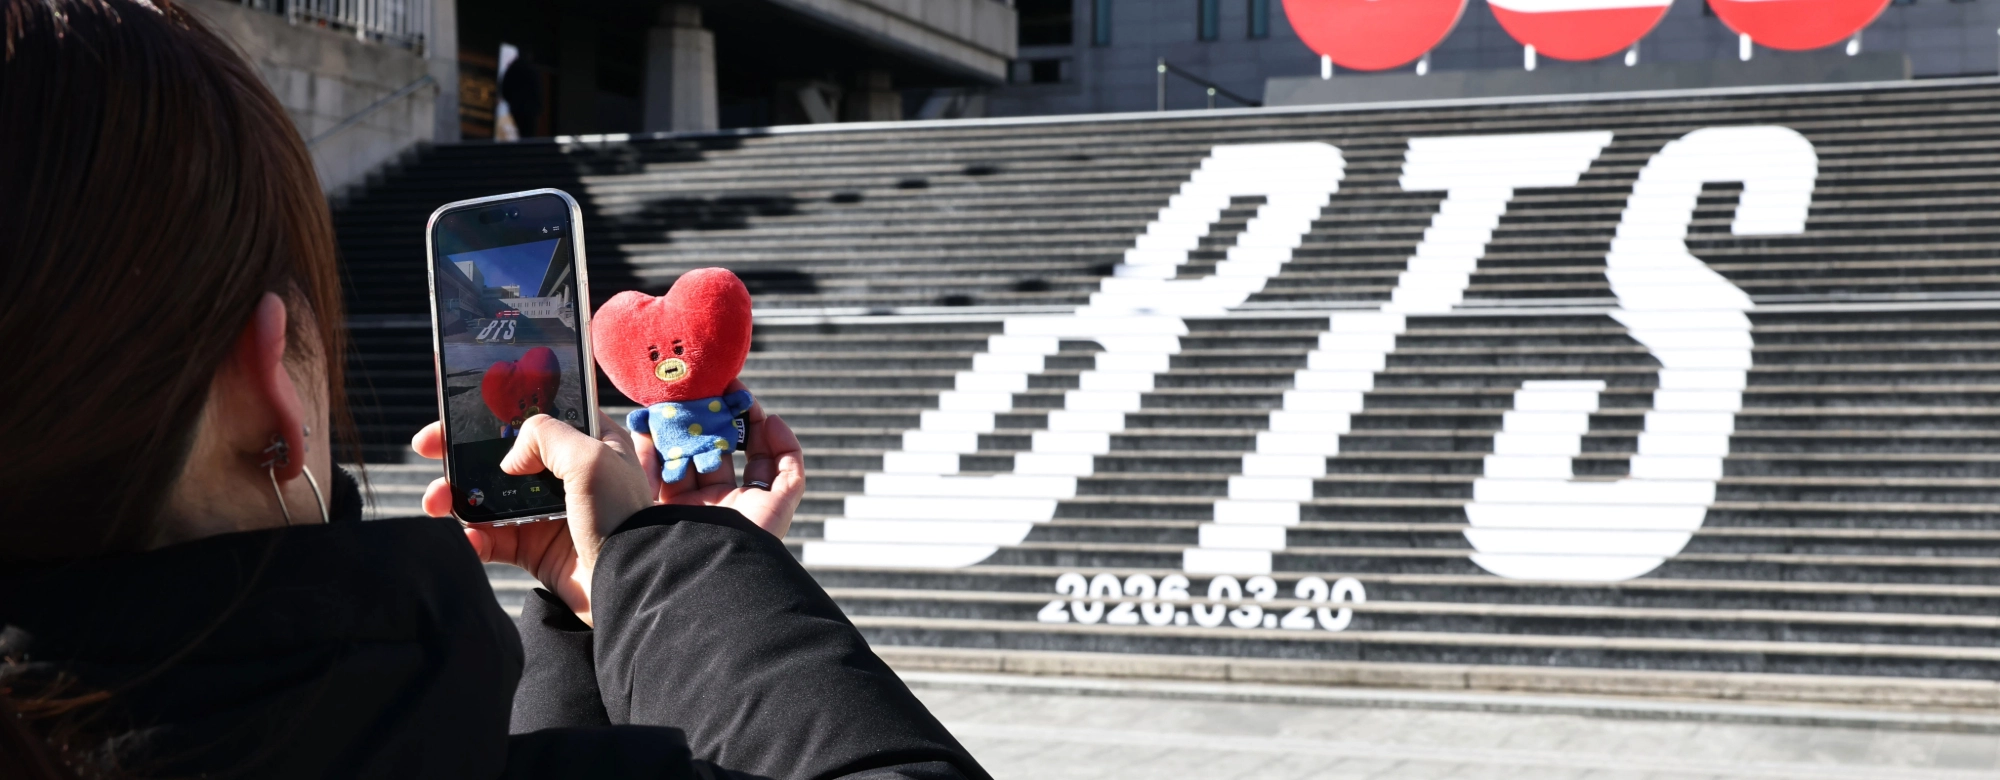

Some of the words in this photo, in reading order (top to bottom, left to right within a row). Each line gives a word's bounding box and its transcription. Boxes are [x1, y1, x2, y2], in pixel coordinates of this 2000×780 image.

[476, 319, 516, 340] BTS
[803, 125, 1818, 582] BTS
[735, 419, 745, 443] BT21
[502, 489, 517, 497] ビデオ
[1037, 572, 1367, 632] 2026.03.20
